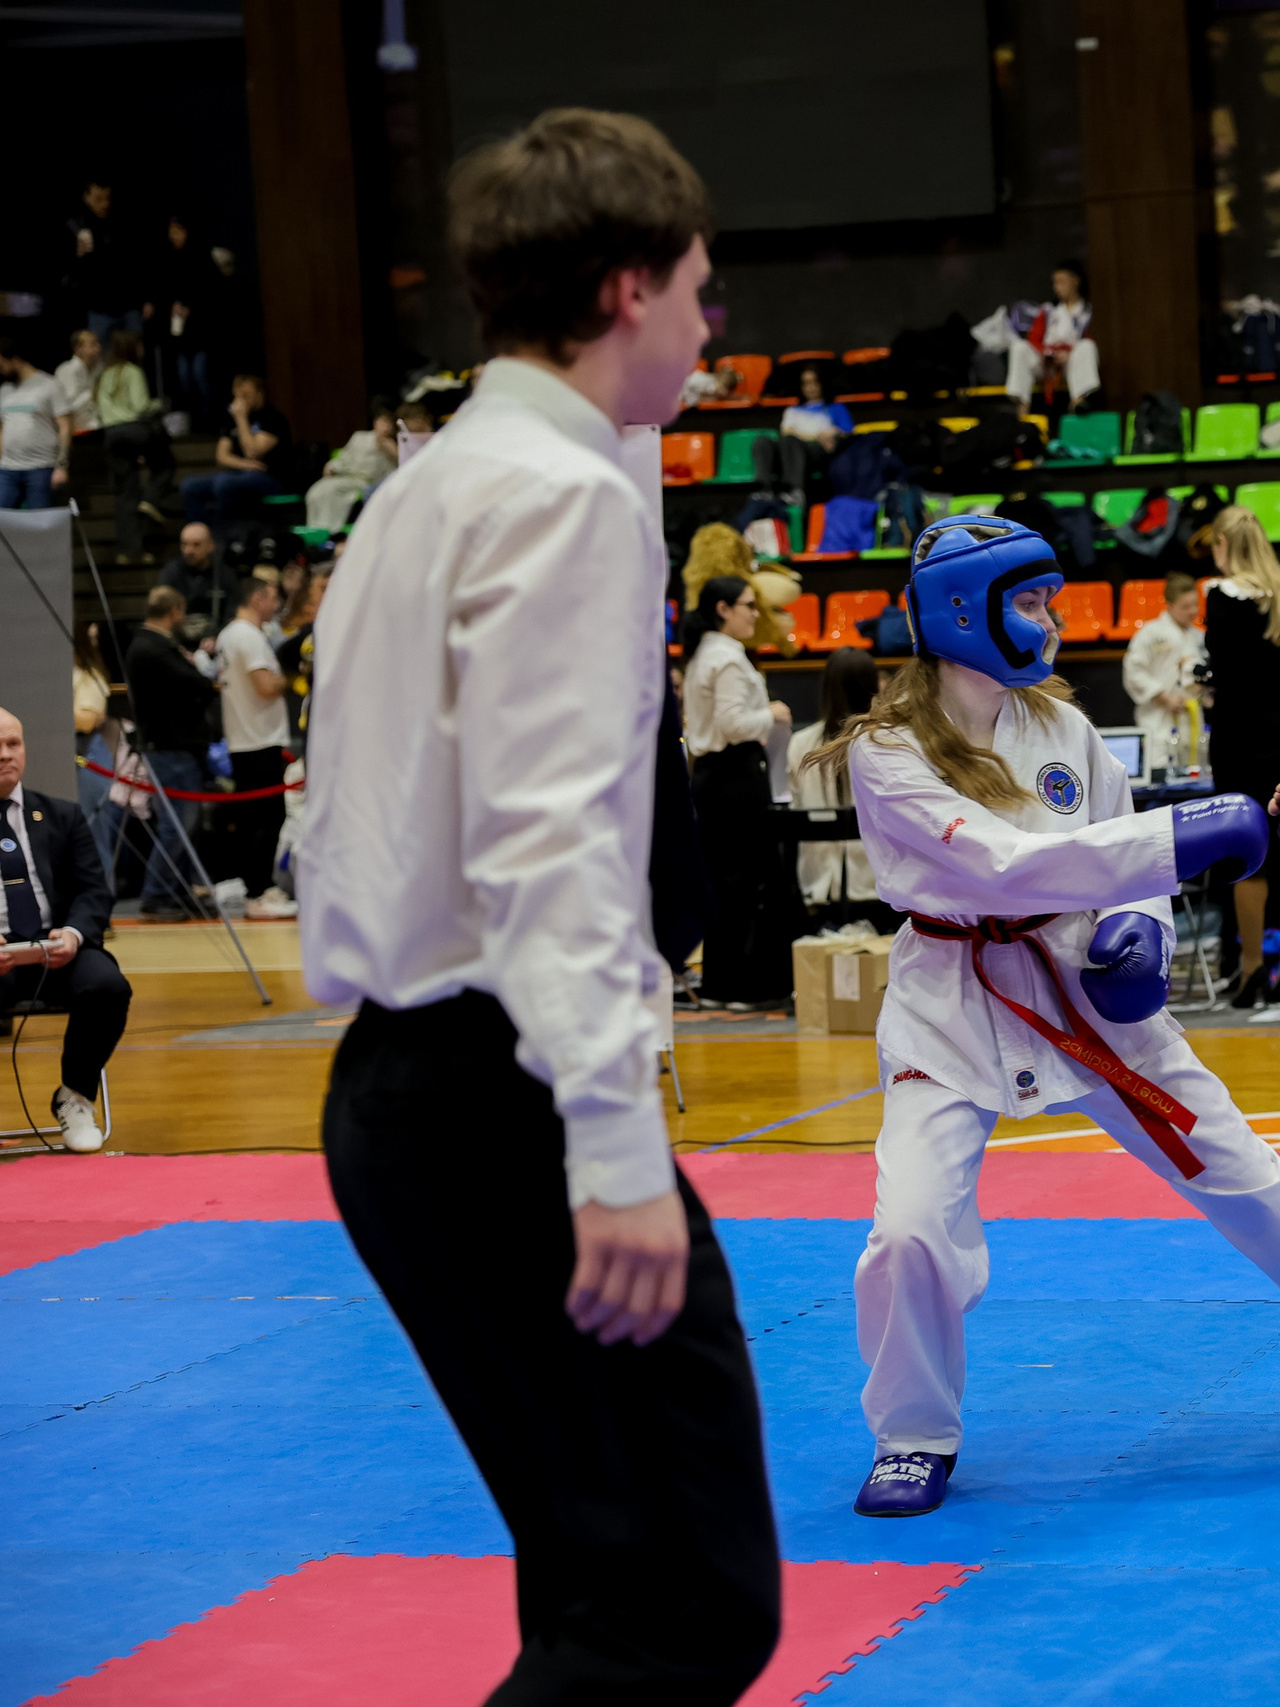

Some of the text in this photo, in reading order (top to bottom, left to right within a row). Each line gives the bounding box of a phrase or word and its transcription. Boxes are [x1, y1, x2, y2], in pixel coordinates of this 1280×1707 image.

[1179, 801, 1212, 815] TOP
[872, 1463, 932, 1480] TOP TEN
[875, 1473, 921, 1483] FIGHT
